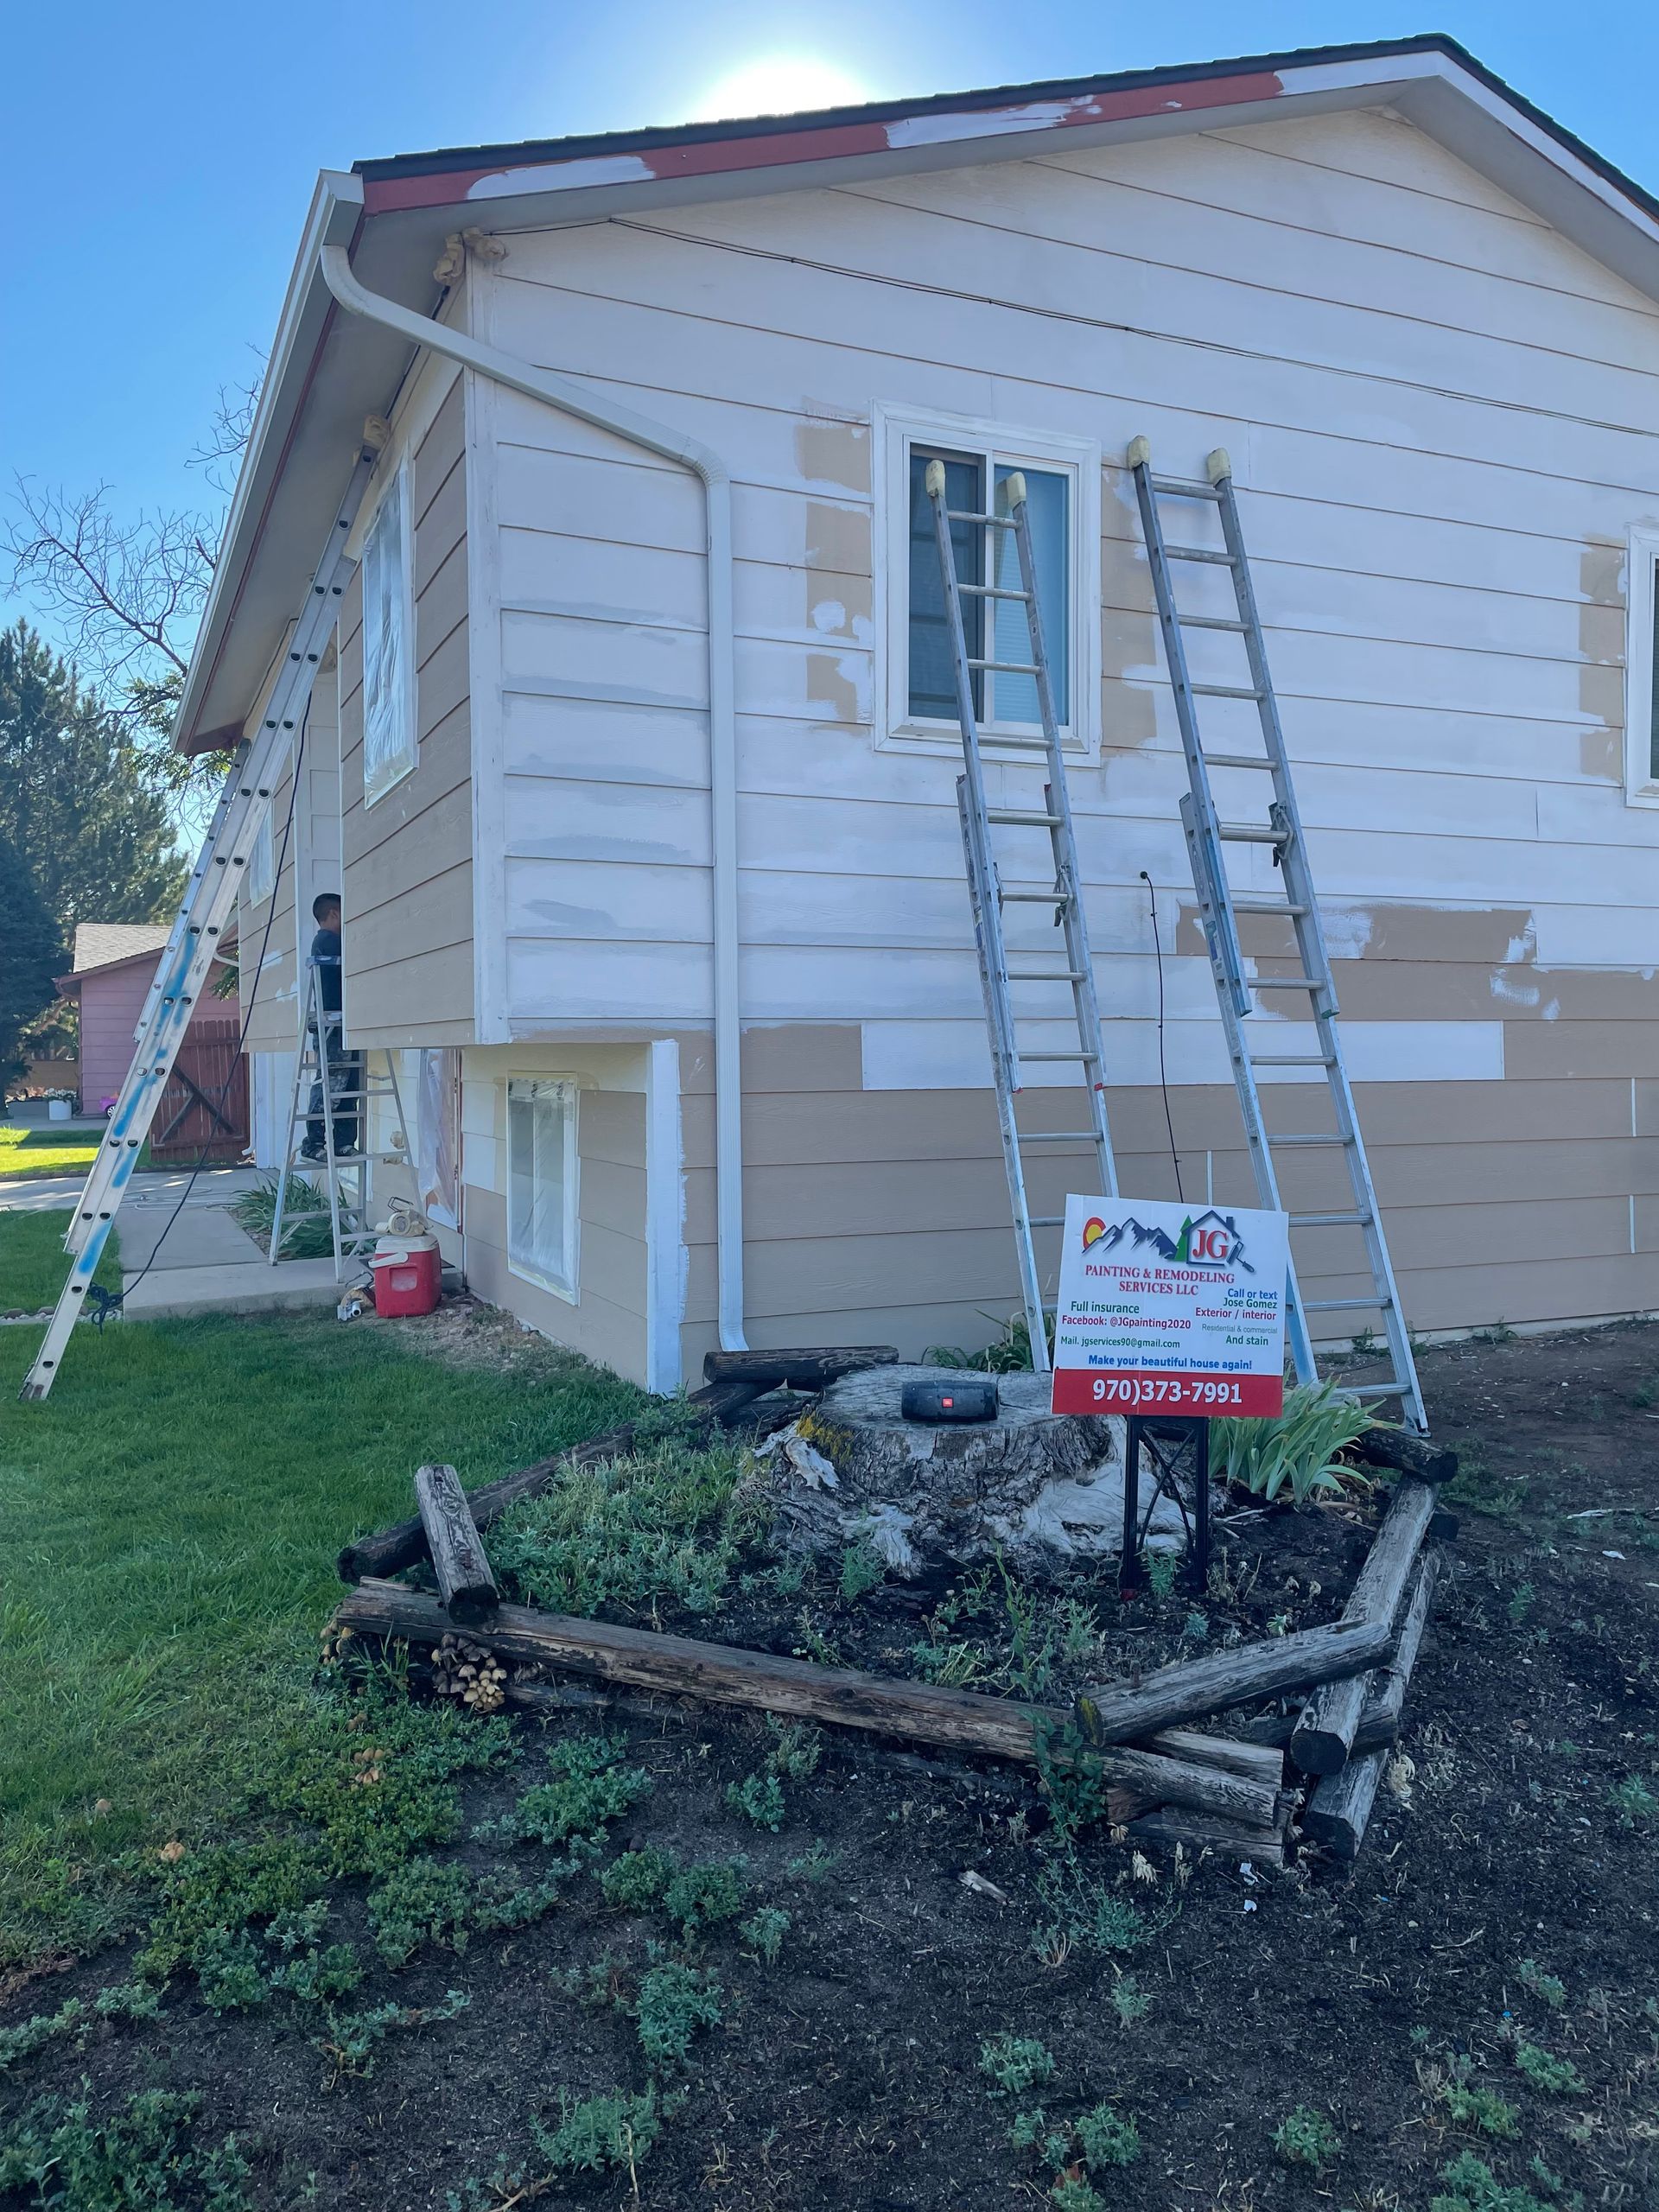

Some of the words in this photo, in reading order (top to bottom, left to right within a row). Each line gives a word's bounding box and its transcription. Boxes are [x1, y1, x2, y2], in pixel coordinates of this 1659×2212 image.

[1192, 1230, 1228, 1258] JG
[1085, 1265, 1141, 1278] PAINTING
[1143, 1268, 1151, 1279] &
[1154, 1268, 1235, 1284] REMODELING
[1119, 1281, 1173, 1294] SERVICES
[1176, 1284, 1198, 1295] LLC
[1228, 1288, 1244, 1298] Call
[1260, 1290, 1278, 1300] text
[1071, 1300, 1089, 1312] Full
[1091, 1301, 1140, 1313] insurance
[1224, 1297, 1243, 1307] Jose
[1246, 1299, 1278, 1309] Gomez
[1195, 1307, 1232, 1318] Exterior
[1235, 1309, 1239, 1319] /
[1243, 1309, 1276, 1320] interior
[1062, 1315, 1107, 1325] Facebook:
[1110, 1316, 1191, 1330] @JGpainting2020
[1202, 1324, 1236, 1332] Residential
[1060, 1336, 1079, 1344] Mail.
[1081, 1336, 1180, 1349] jgservices90@gmail.com
[1225, 1335, 1243, 1344] And
[1246, 1336, 1268, 1345] stain
[1088, 1355, 1115, 1365] Make
[1116, 1356, 1139, 1367] your
[1141, 1356, 1187, 1368] beautiful
[1190, 1358, 1219, 1368] house
[1222, 1360, 1252, 1371] again!
[1092, 1378, 1243, 1406] 970)373-7991
